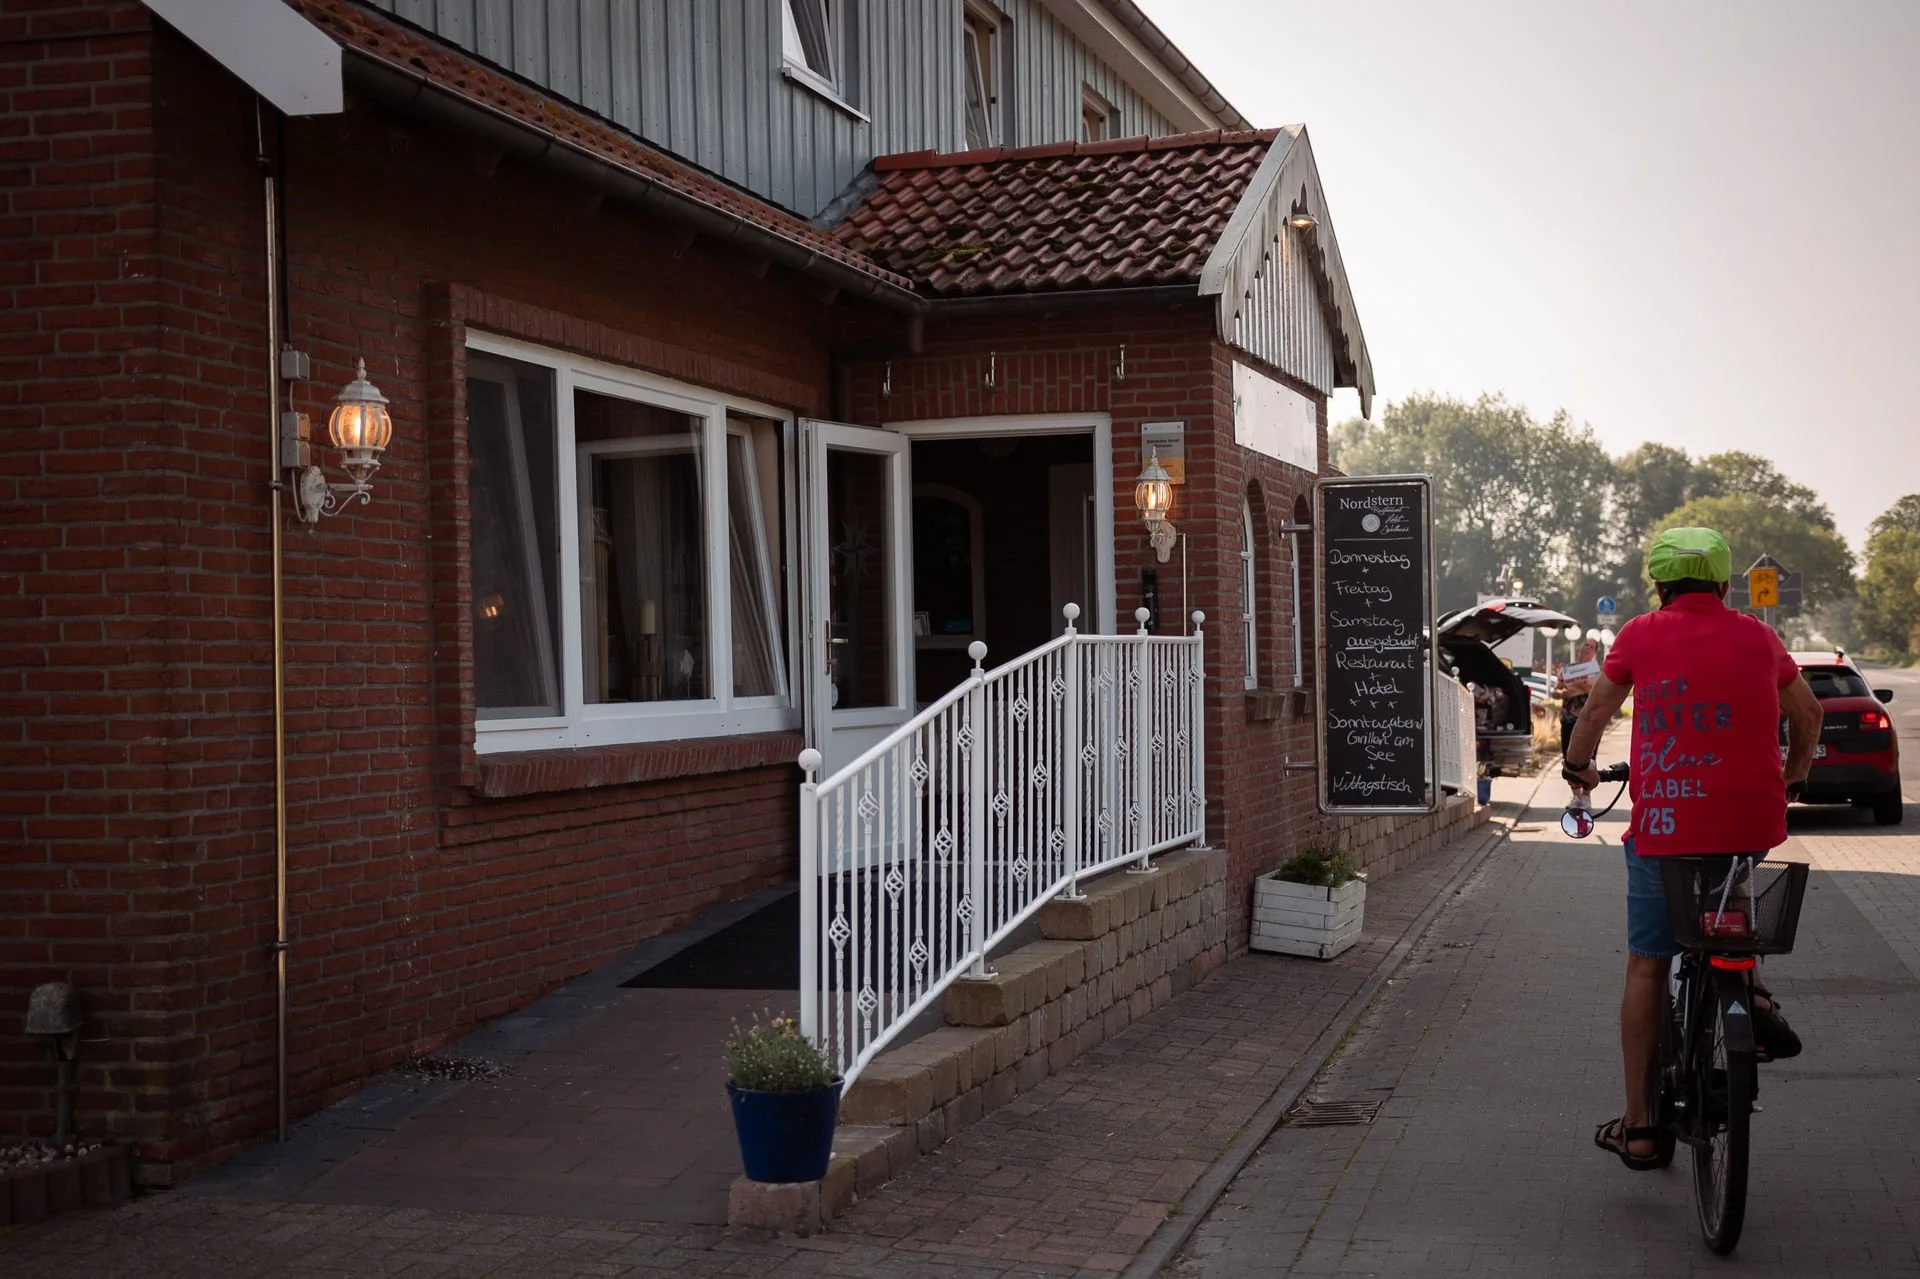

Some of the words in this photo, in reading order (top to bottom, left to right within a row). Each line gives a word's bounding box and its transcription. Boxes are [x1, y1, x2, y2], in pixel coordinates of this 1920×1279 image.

[1340, 495, 1403, 509] Nordstern
[1332, 580, 1392, 602] Freitag
[1330, 611, 1404, 635] Samstag
[1354, 677, 1404, 696] Hotel
[1347, 730, 1389, 745] Grillen
[1394, 736, 1415, 748] am
[1365, 745, 1396, 762] See
[1640, 735, 1723, 776] Blue
[1333, 771, 1412, 796] Mittagstisch
[1641, 778, 1708, 799] LABEL
